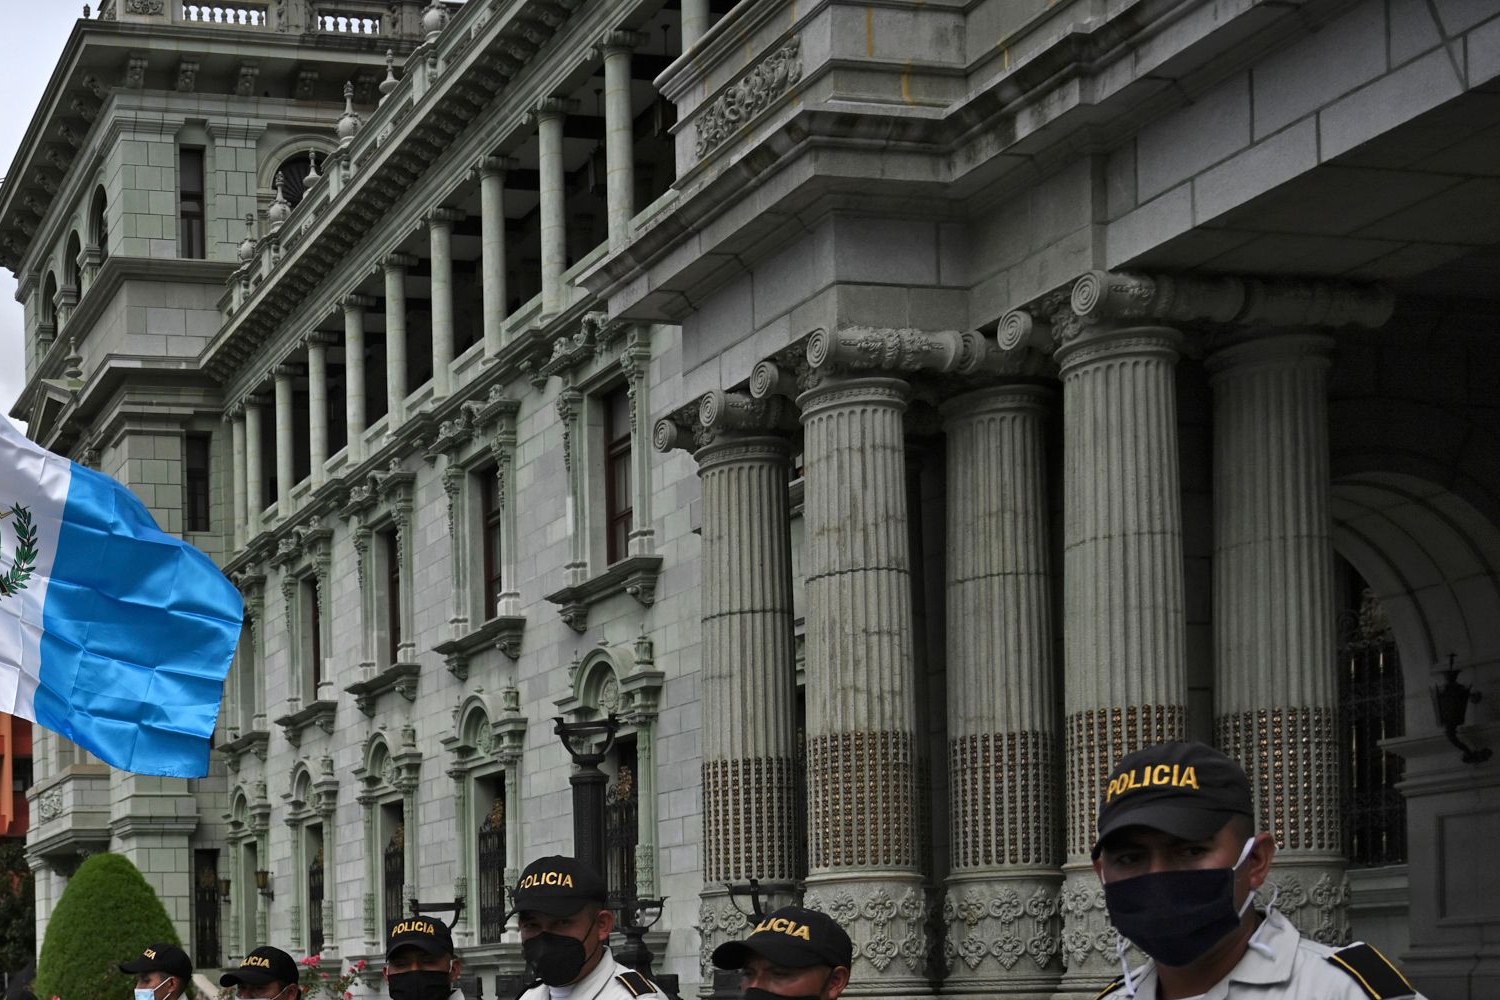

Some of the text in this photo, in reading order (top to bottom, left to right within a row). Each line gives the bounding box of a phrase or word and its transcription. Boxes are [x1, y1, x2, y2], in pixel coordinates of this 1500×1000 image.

[1106, 763, 1200, 803] POLICIA
[391, 921, 436, 938] POLICIA
[750, 917, 811, 941] LICIA
